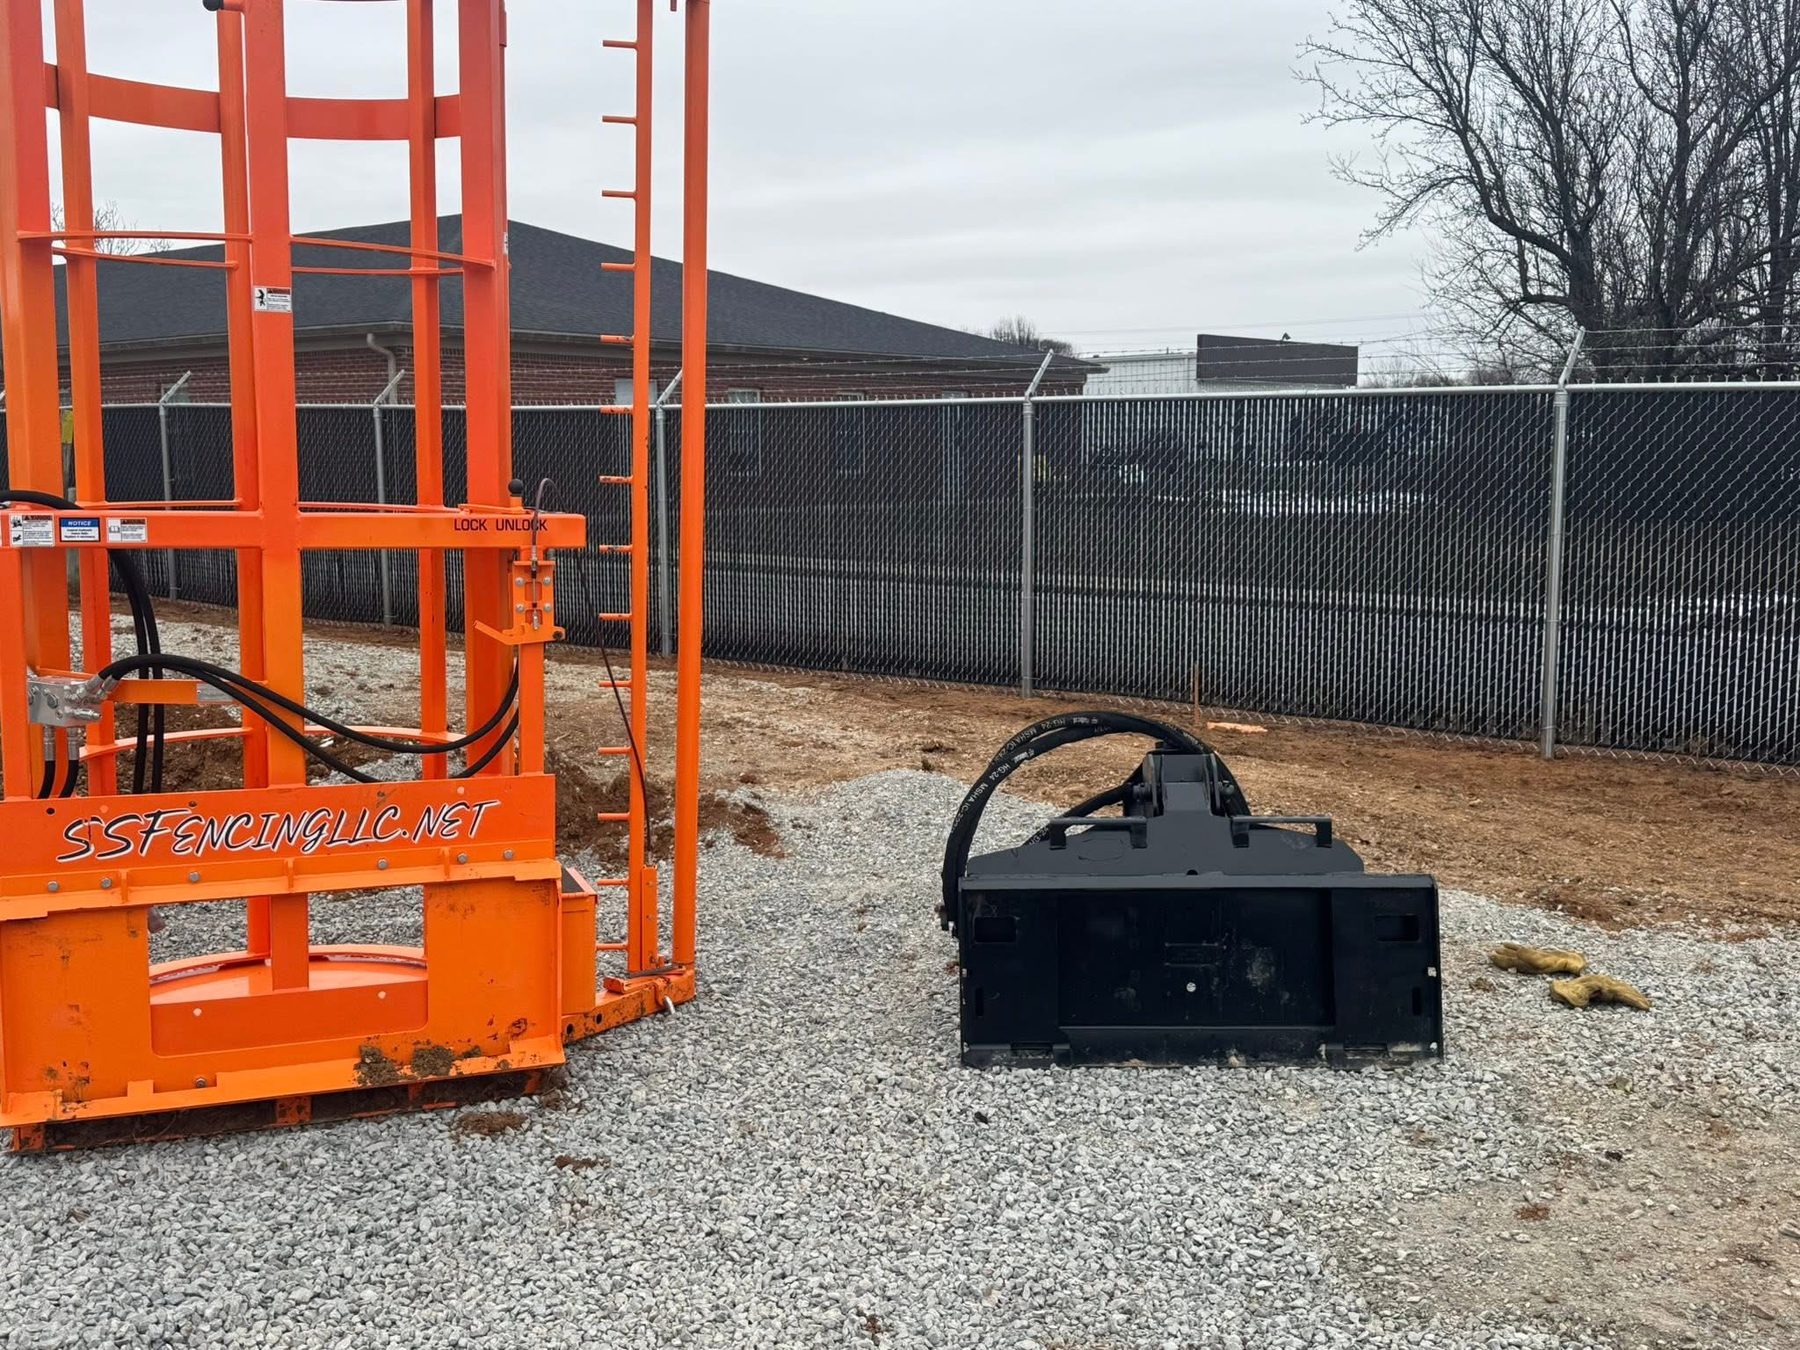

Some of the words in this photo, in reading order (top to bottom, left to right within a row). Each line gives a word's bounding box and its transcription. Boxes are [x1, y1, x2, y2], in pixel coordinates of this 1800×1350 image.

[454, 518, 488, 531] LOCK
[495, 518, 548, 531] UNLOCK
[988, 762, 1012, 781] HG-24
[967, 782, 989, 802] MSHA
